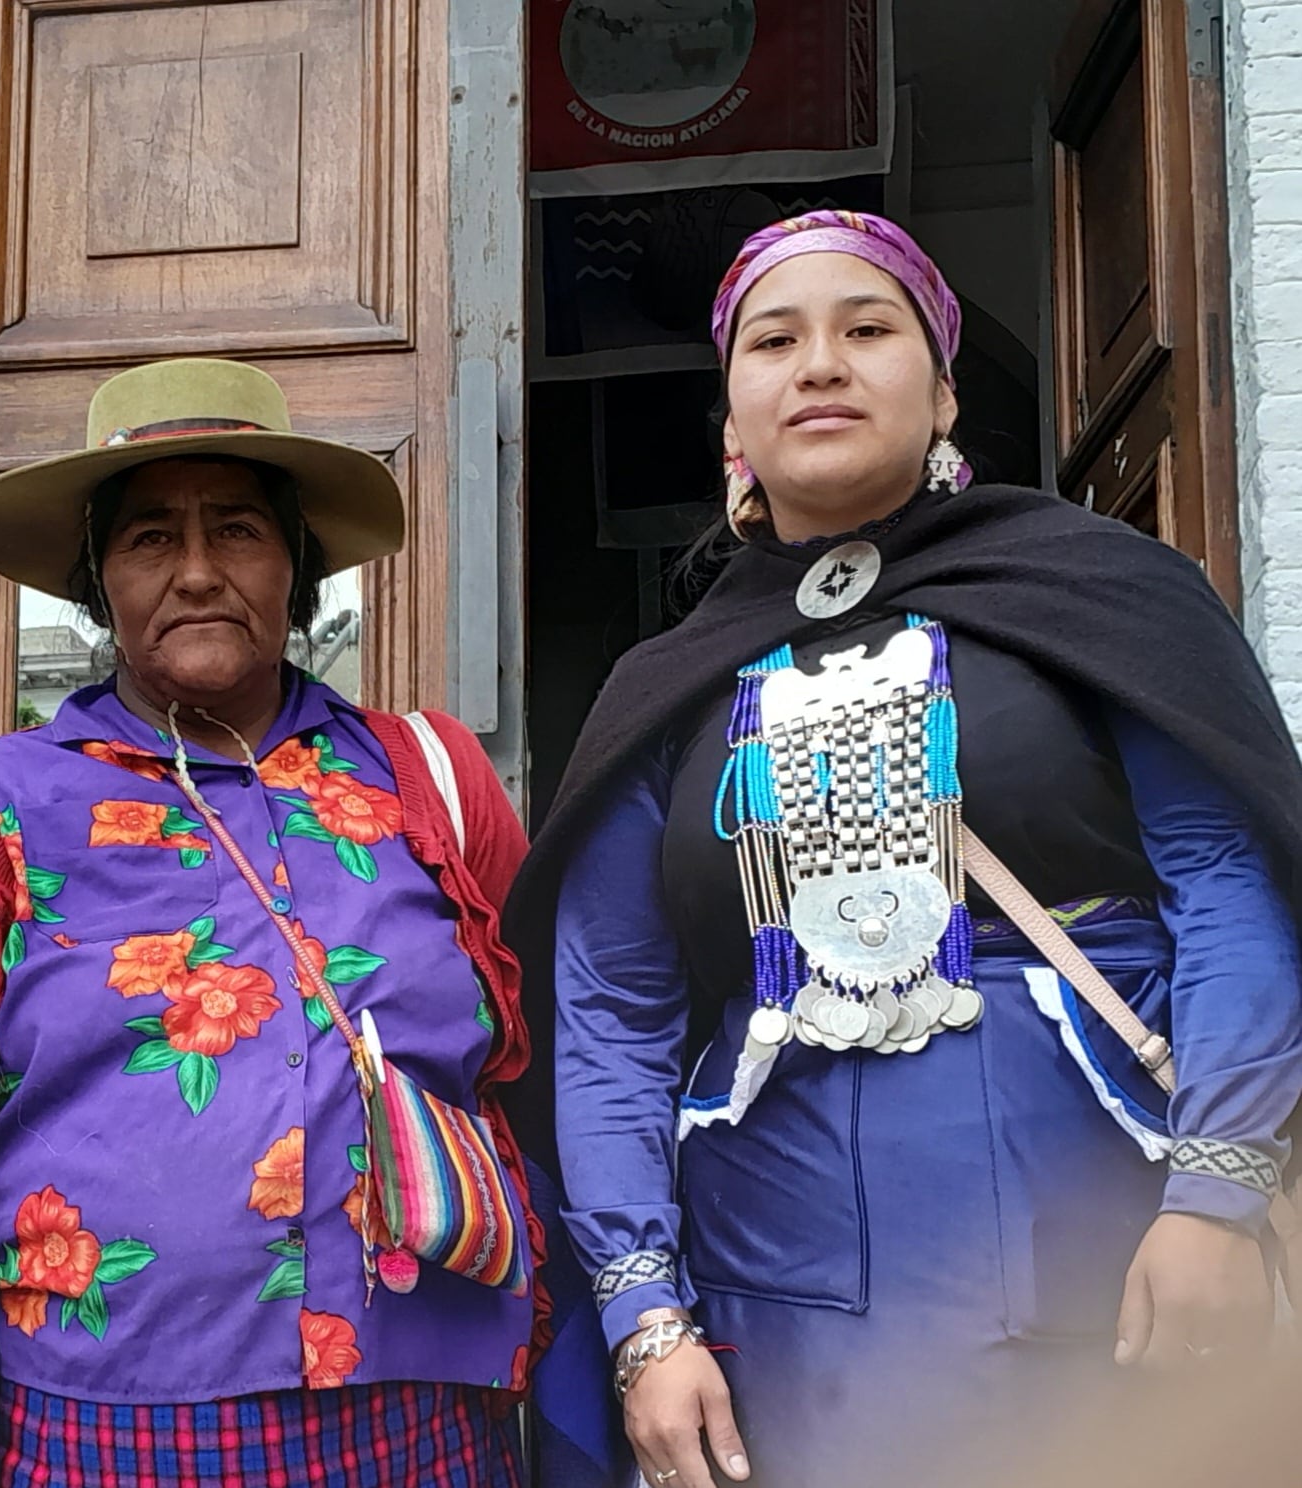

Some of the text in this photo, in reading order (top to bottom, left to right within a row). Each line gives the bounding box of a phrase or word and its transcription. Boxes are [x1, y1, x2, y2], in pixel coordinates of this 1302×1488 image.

[566, 87, 751, 148] DE LA NACION ATACAMA
